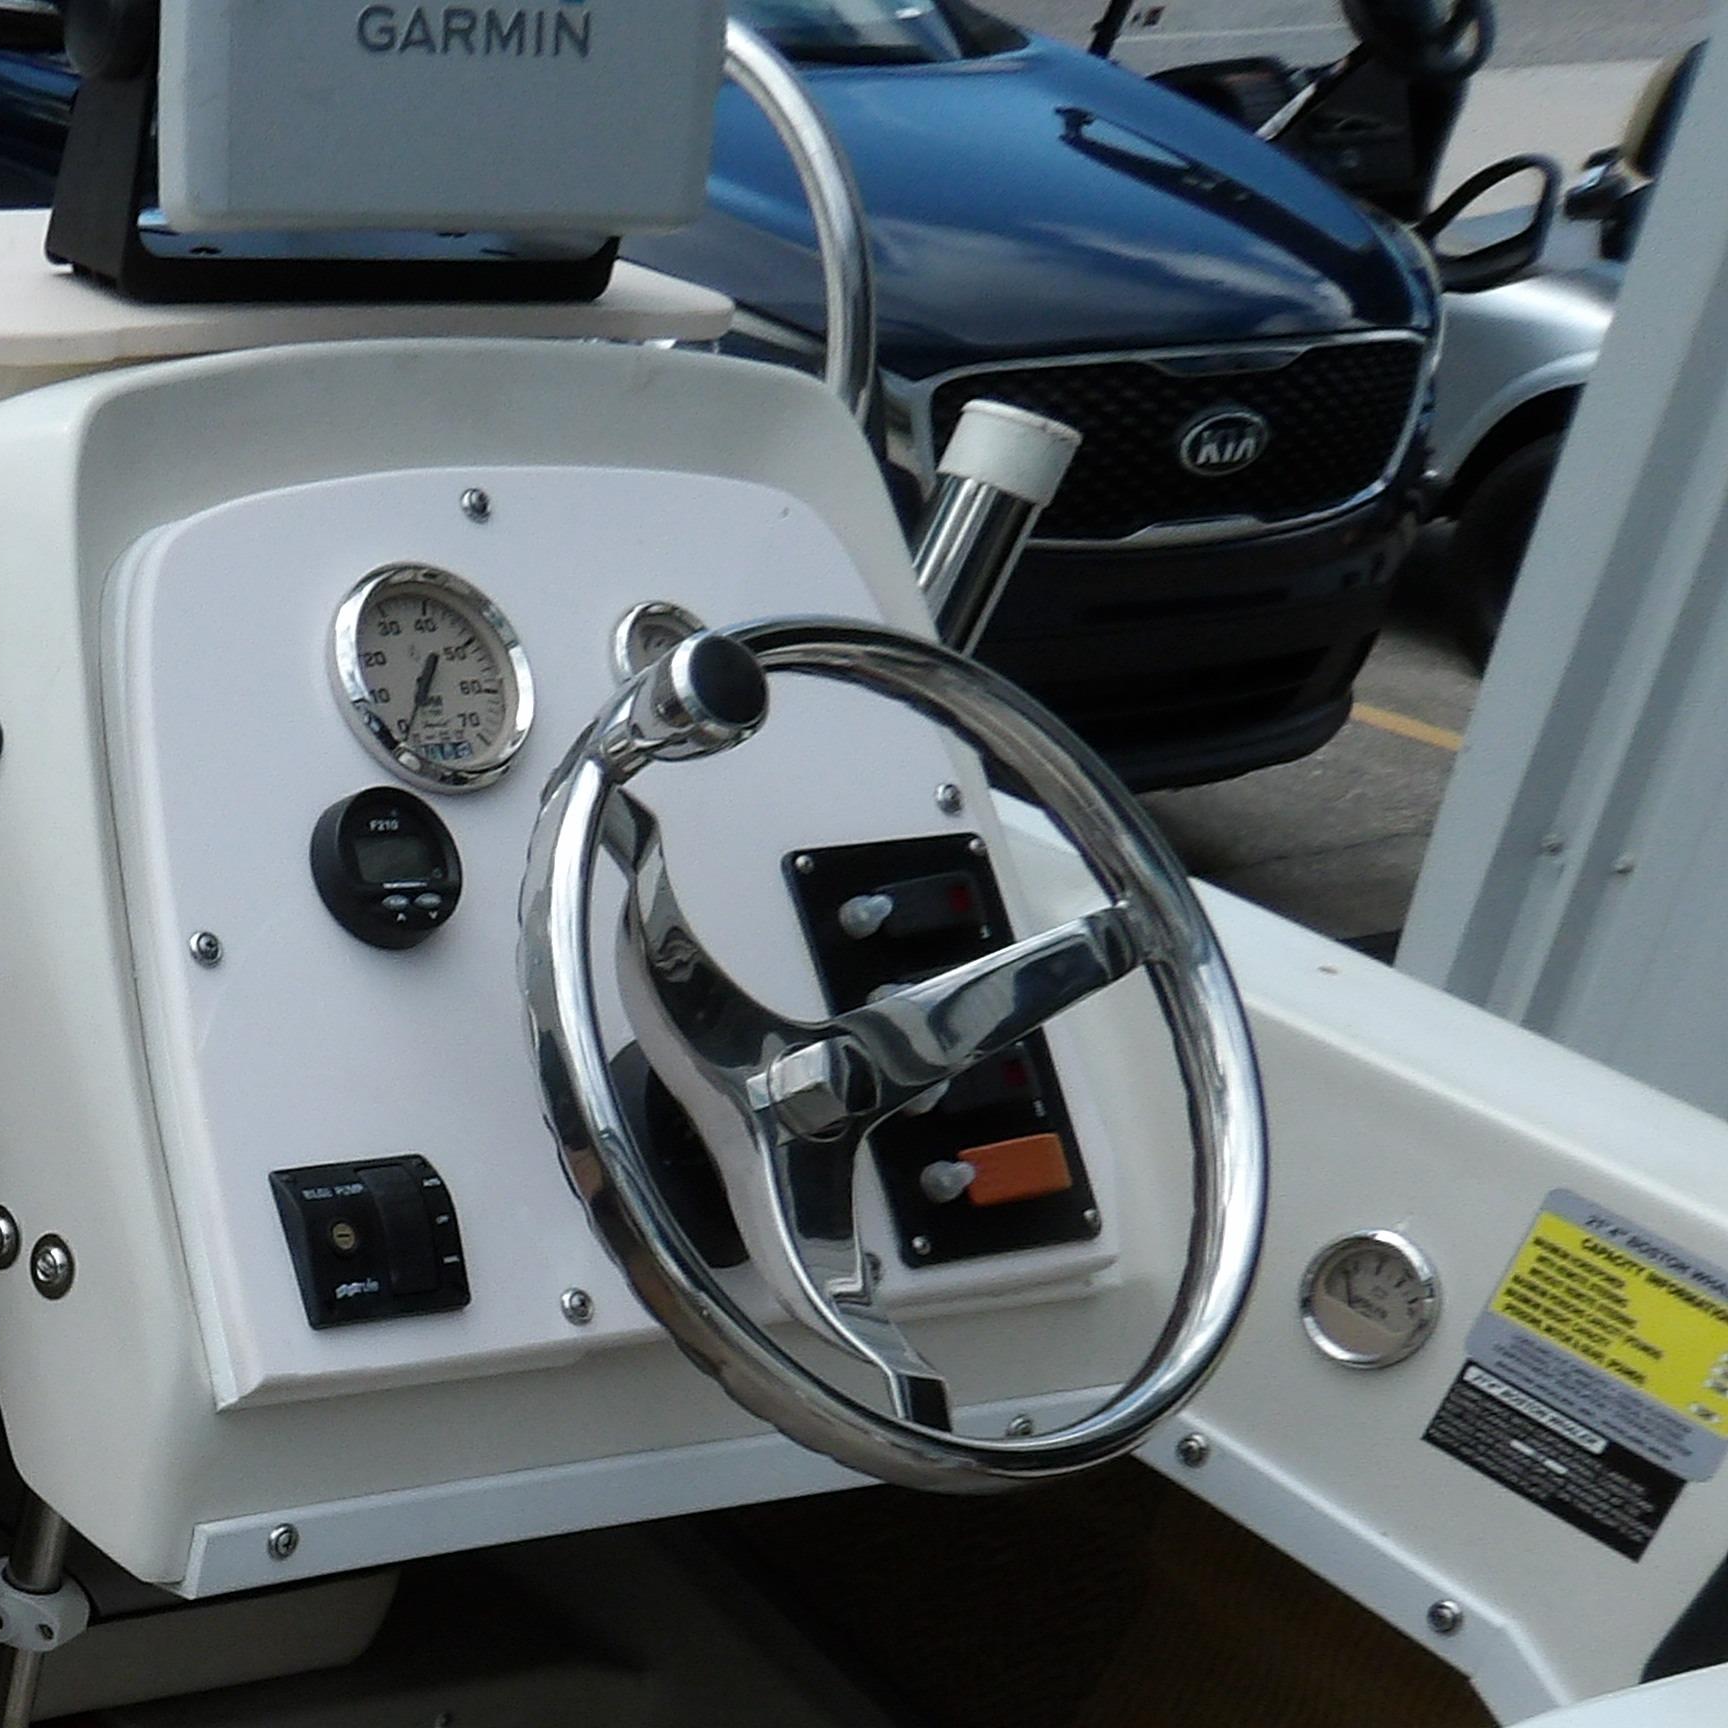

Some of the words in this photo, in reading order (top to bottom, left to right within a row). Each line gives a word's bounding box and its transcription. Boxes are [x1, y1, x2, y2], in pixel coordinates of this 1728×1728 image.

[355, 5, 591, 58] GARMIN
[1196, 429, 1255, 465] KIA
[378, 620, 401, 638] 30
[414, 617, 437, 633] 40
[363, 651, 387, 668] 20
[443, 646, 467, 661] 50
[370, 687, 390, 705] 10
[459, 679, 482, 696] 60
[457, 712, 480, 728] 70
[1625, 1234, 1692, 1274] BOSTON
[1581, 1237, 1647, 1276] CAPACITY
[1645, 1270, 1728, 1323] INFORMATIO
